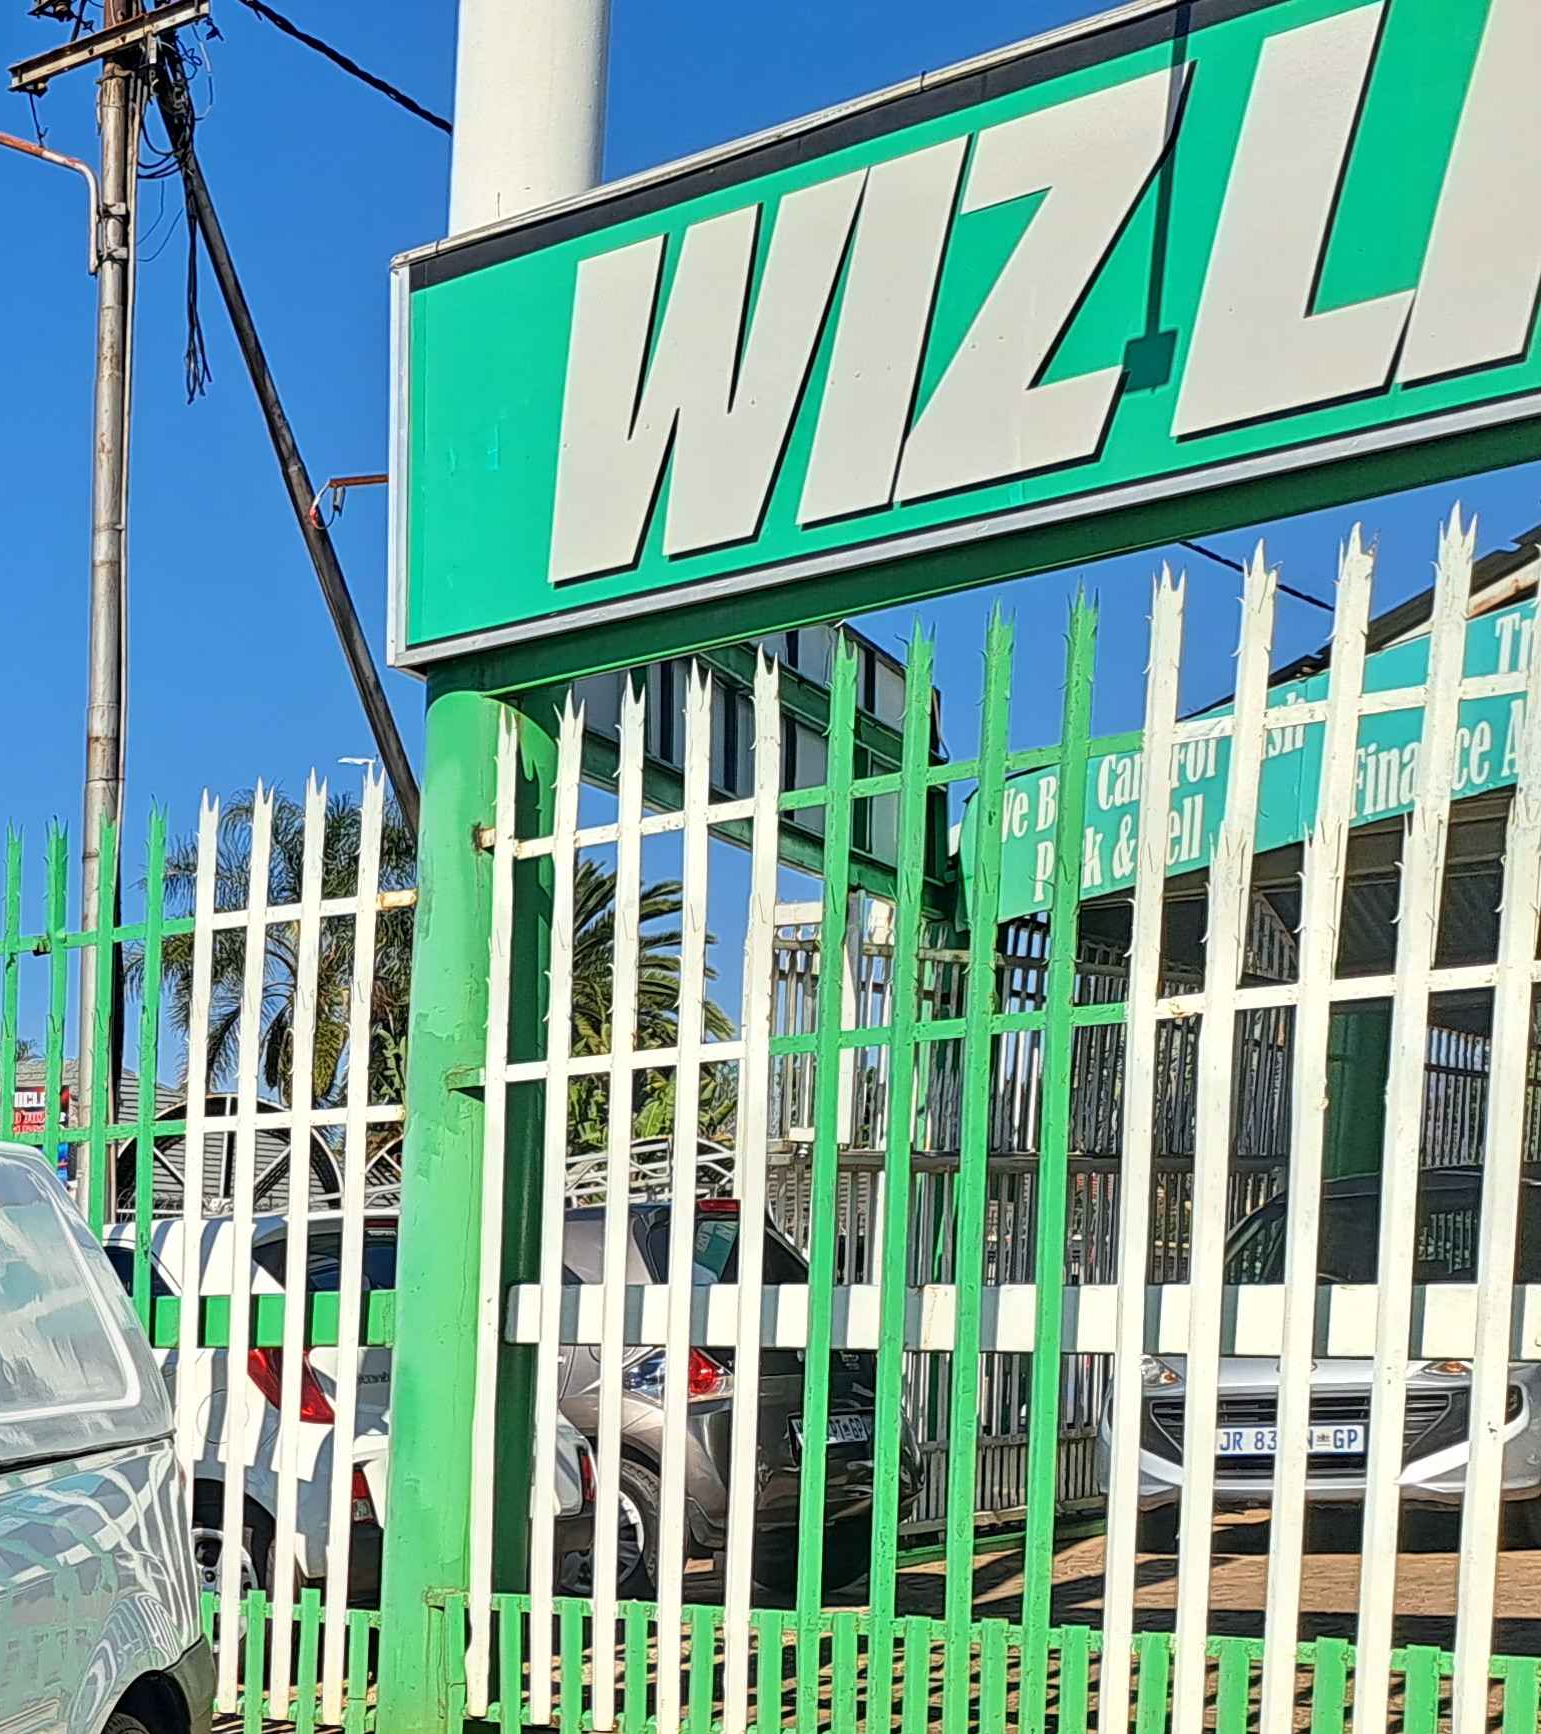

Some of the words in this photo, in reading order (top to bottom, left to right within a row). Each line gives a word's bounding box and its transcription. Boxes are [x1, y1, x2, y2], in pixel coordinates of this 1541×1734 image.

[1350, 721, 1493, 818] Finace
[1167, 794, 1204, 866] ell
[1333, 1429, 1359, 1449] GP
